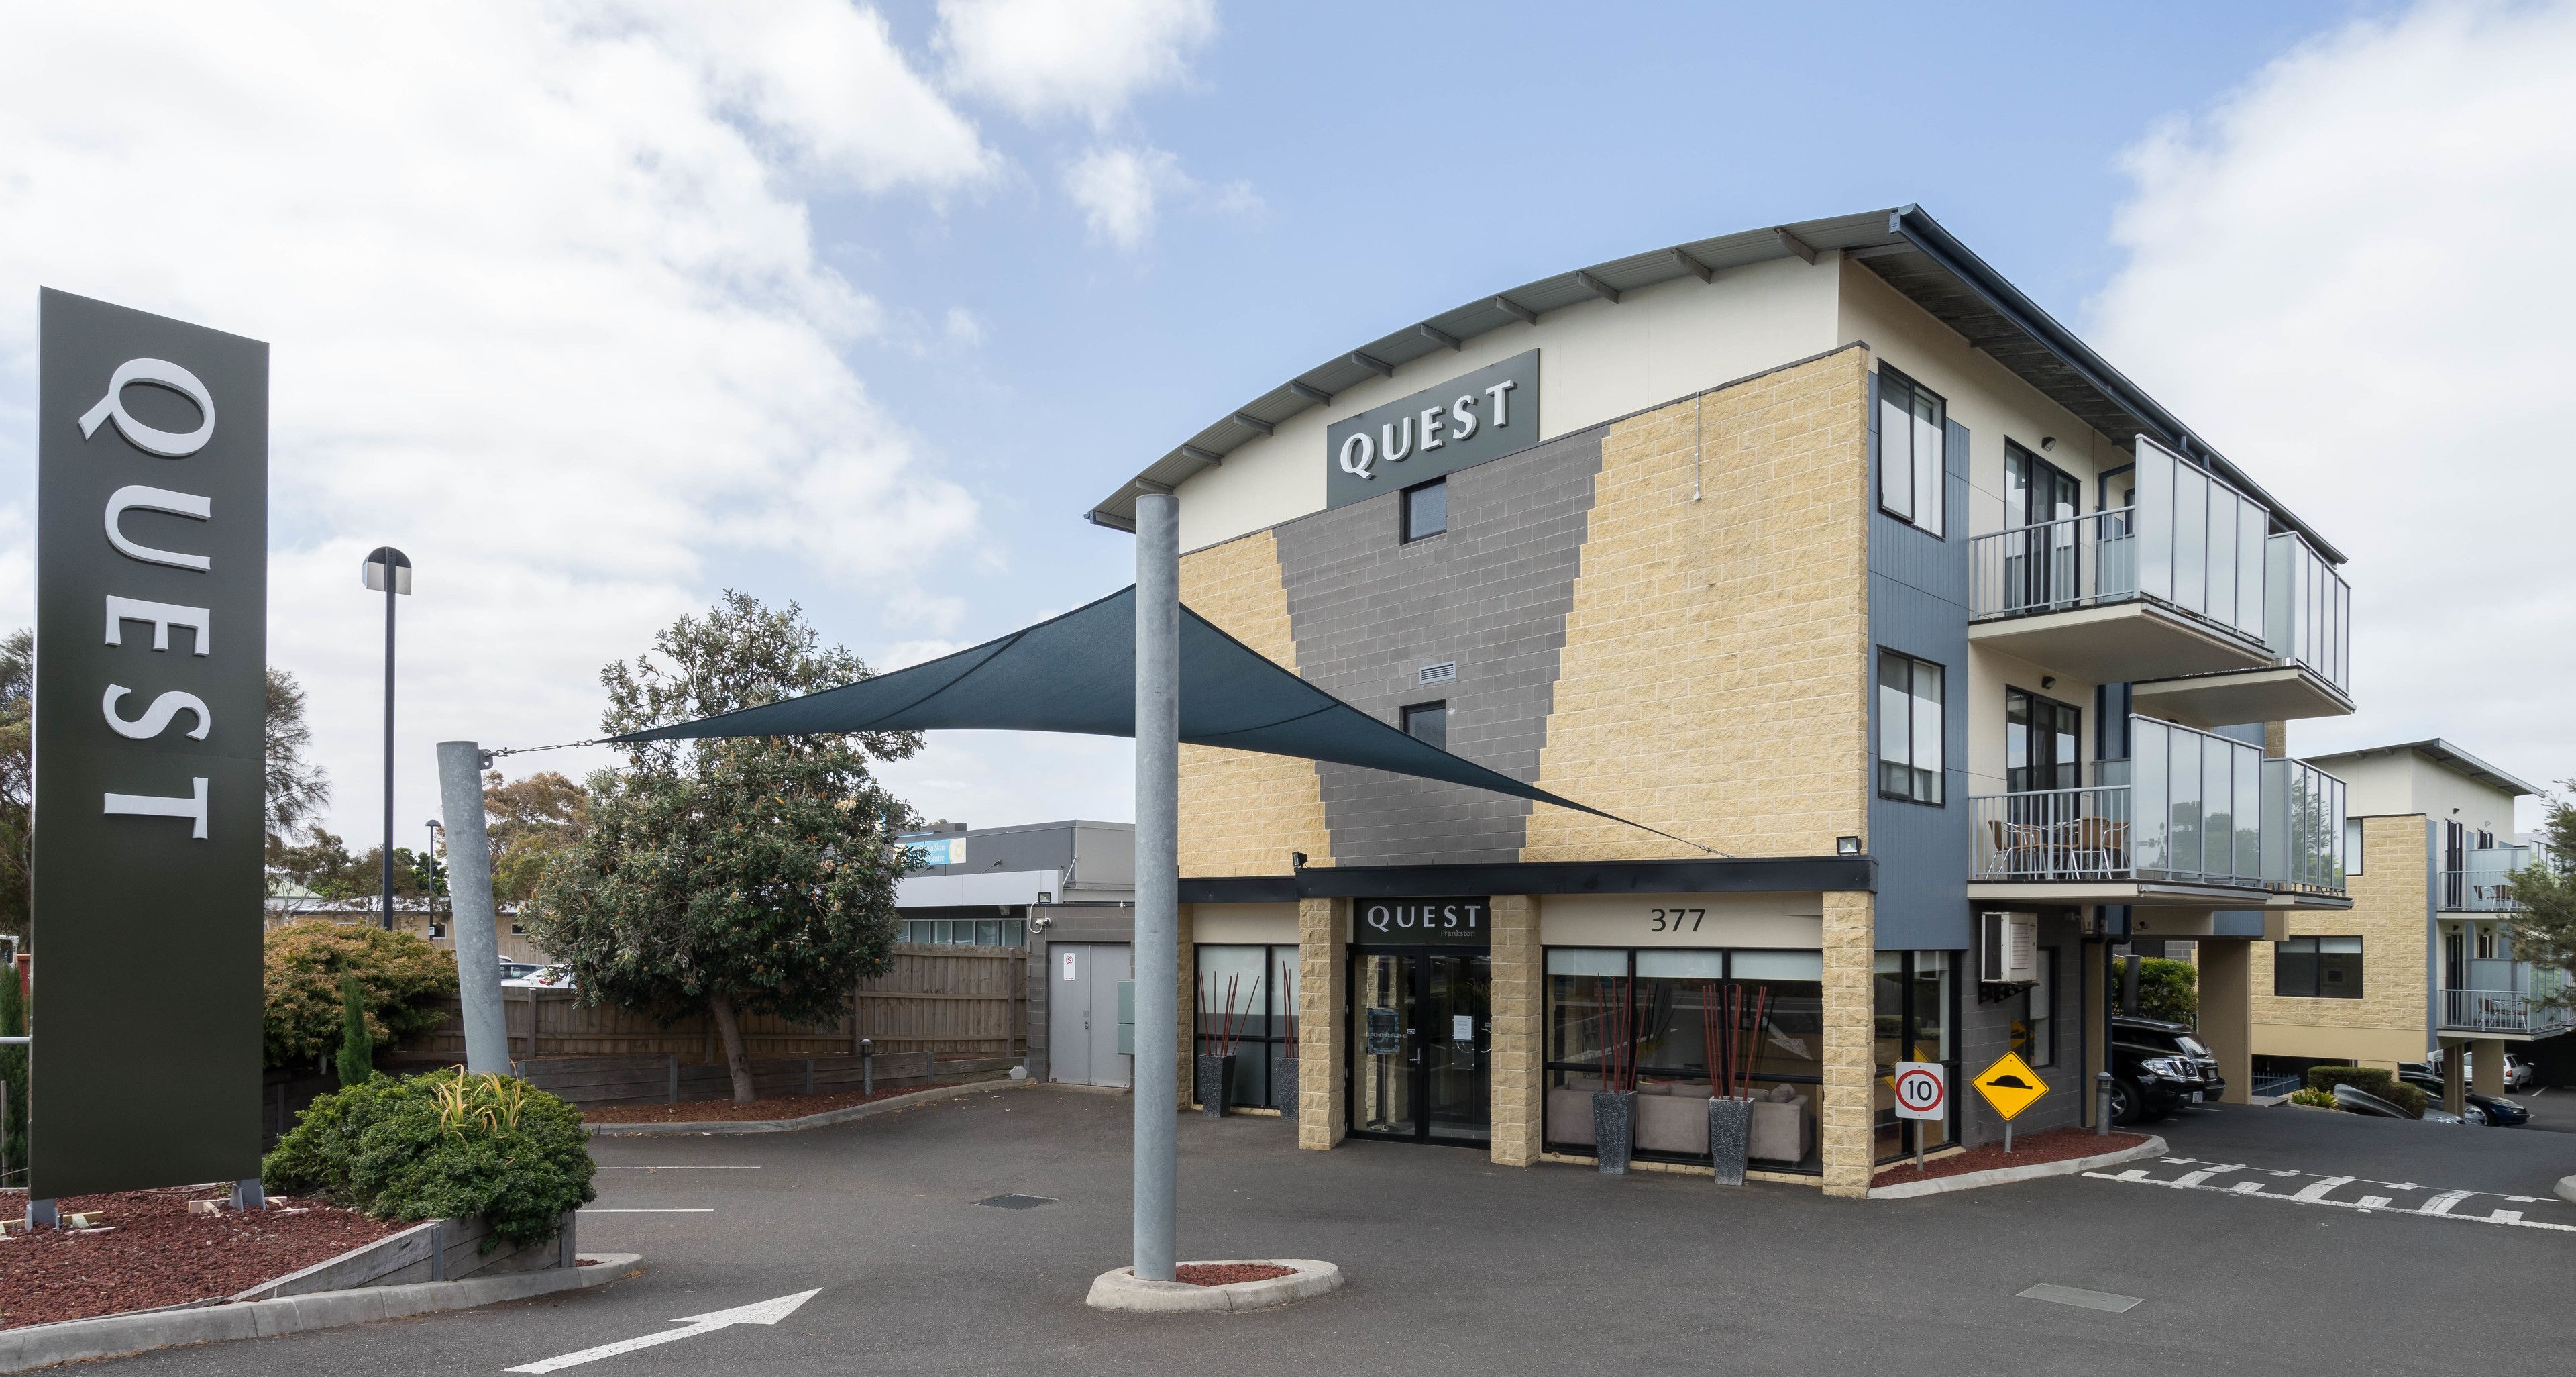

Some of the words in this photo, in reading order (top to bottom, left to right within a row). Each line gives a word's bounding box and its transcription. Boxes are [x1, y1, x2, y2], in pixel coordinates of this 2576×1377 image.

[1340, 380, 1515, 480] QUEST
[78, 358, 216, 840] QUEST
[1367, 905, 1481, 933] QUEST
[1651, 908, 1706, 932] 377
[1908, 1080, 1932, 1101] 10
